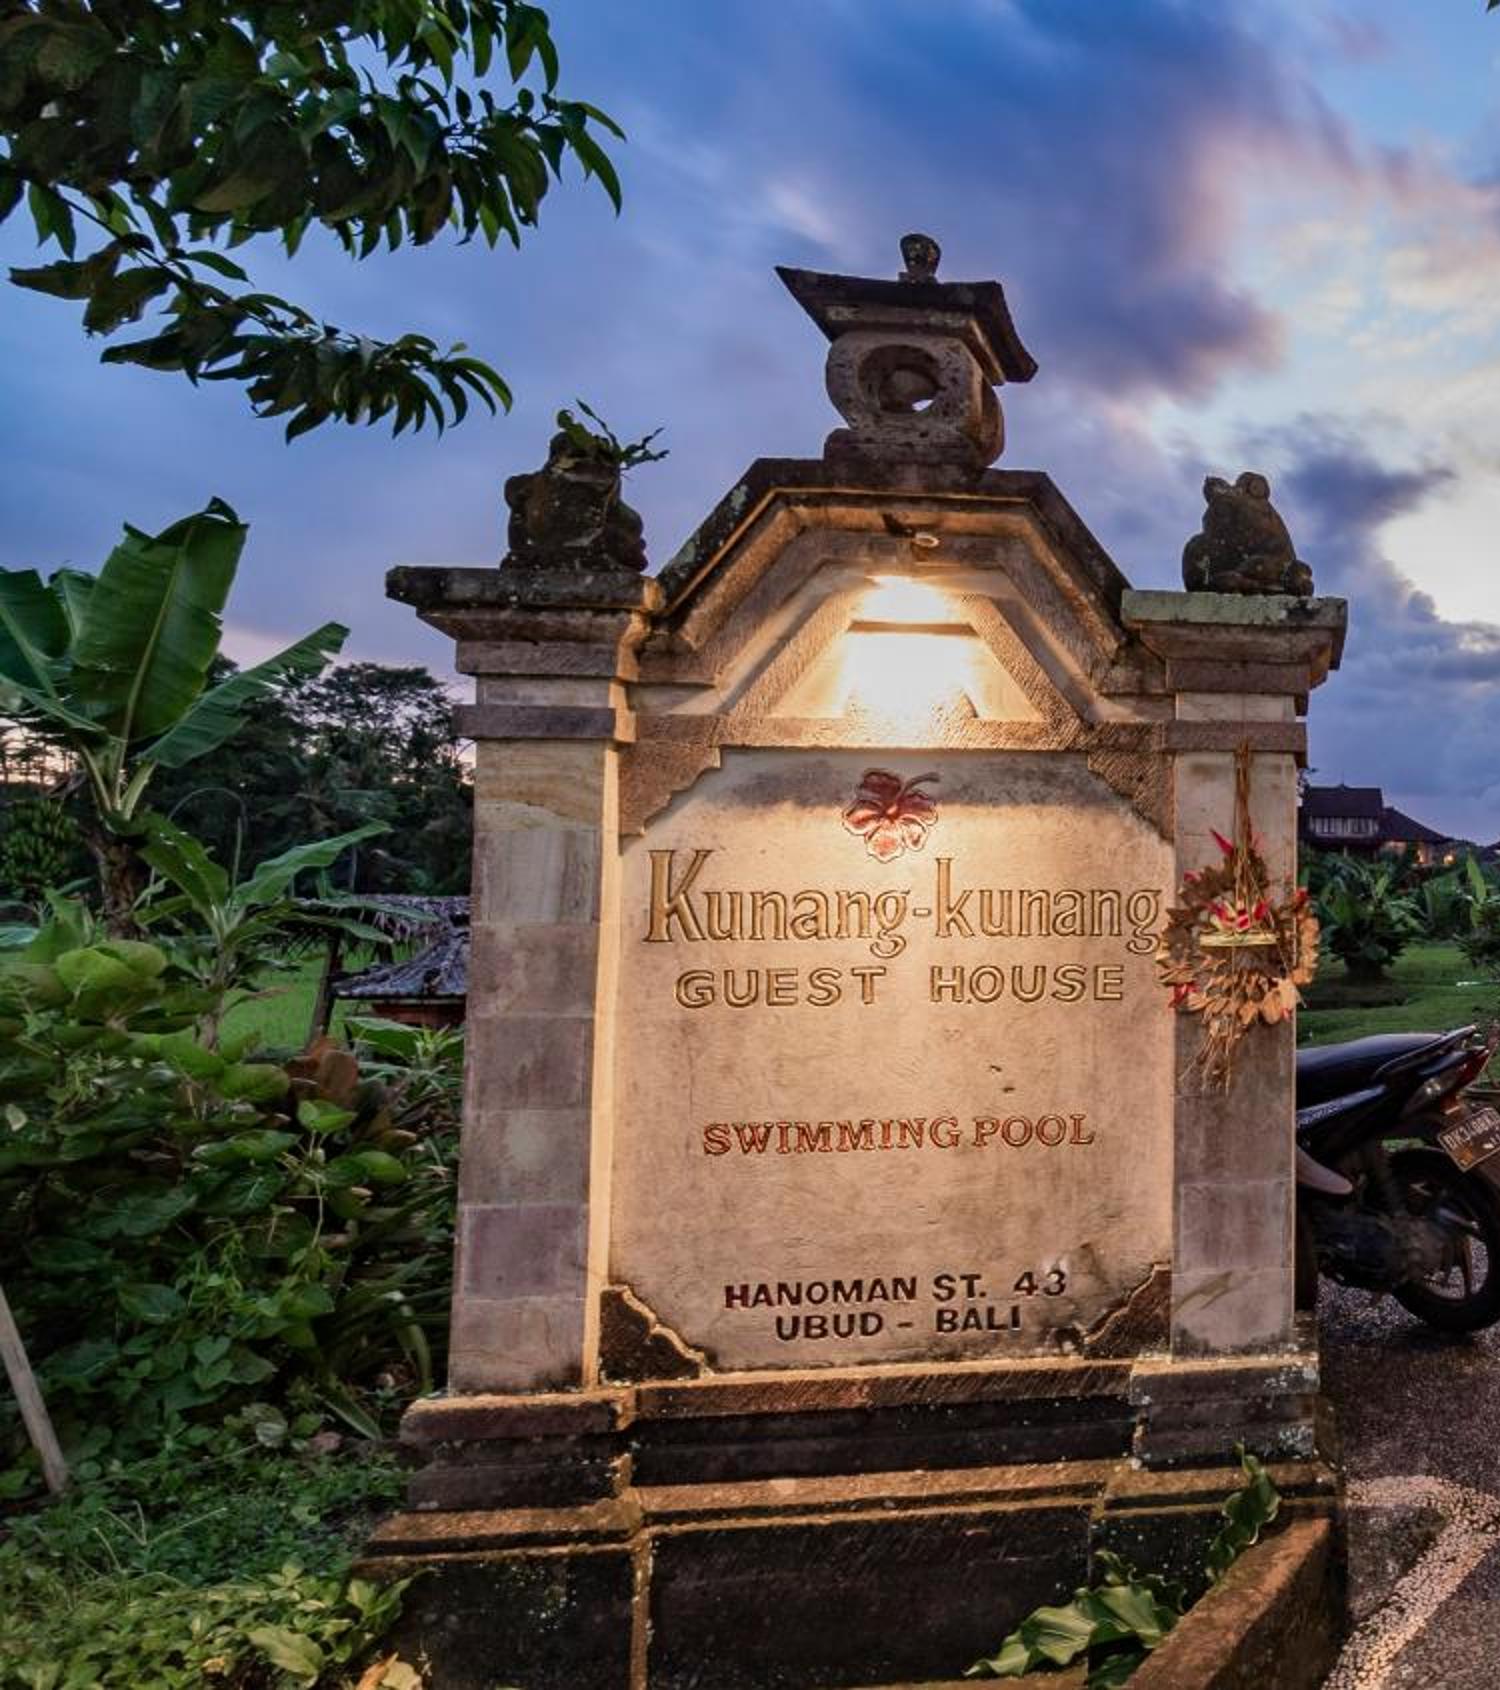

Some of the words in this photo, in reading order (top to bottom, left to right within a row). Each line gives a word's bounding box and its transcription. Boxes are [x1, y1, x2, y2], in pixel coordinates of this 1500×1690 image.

[642, 848, 1163, 958] Kunang-kunang
[674, 965, 888, 1009] GUEST
[929, 963, 1126, 1004] HOUSE
[702, 1117, 962, 1156] SWIMMING
[972, 1113, 1096, 1148] POOL
[724, 1276, 917, 1309] HANOMAN
[932, 1273, 987, 1301] ST.
[1013, 1269, 1067, 1298] 43
[775, 1311, 884, 1341] UBUD
[935, 1305, 1022, 1333] BALI
